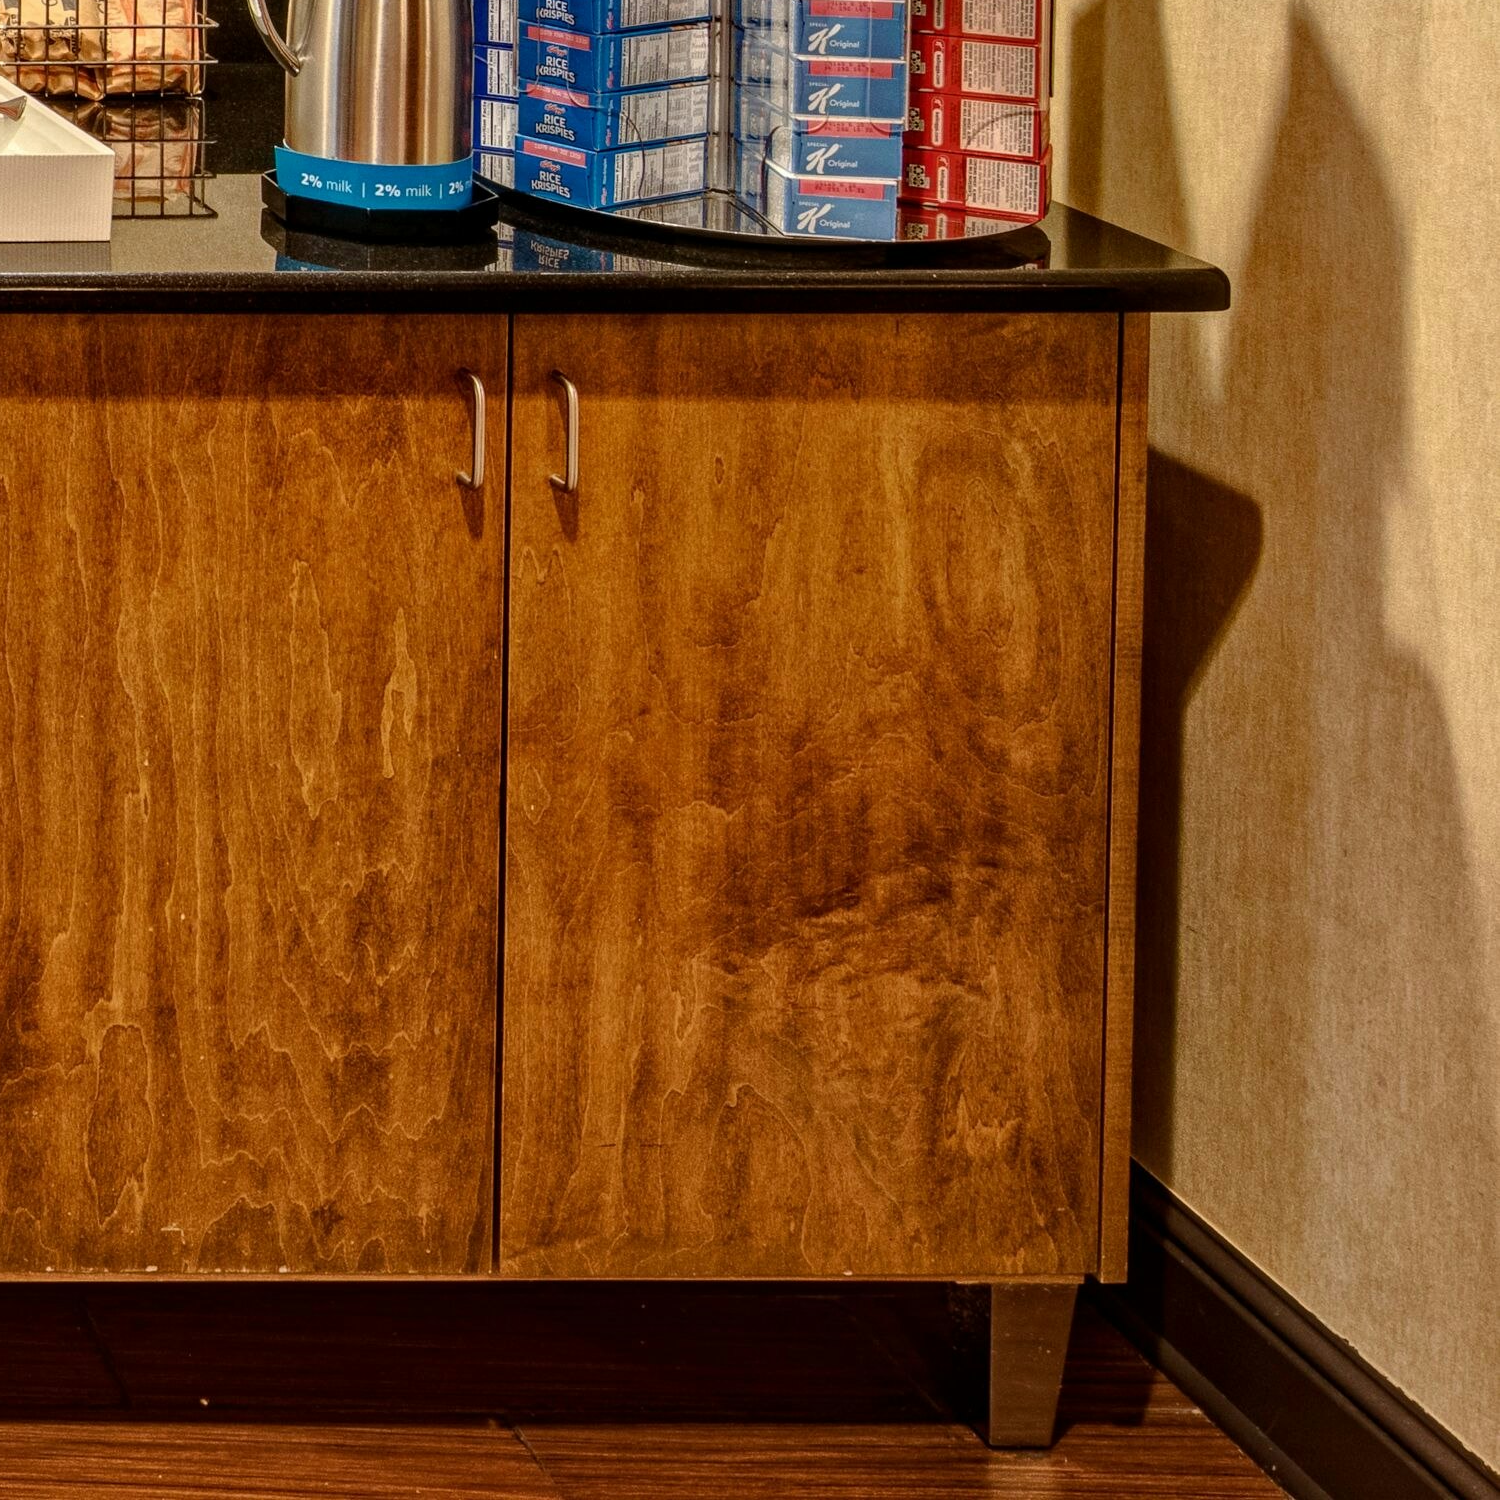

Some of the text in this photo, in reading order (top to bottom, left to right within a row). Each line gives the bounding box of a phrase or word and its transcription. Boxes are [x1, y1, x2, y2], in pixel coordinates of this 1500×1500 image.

[536, 7, 575, 26] KRISPIES
[808, 23, 859, 54] K Original
[545, 56, 569, 70] RICE
[536, 65, 575, 83] KRISPIES
[807, 83, 860, 114] K Original
[544, 114, 566, 128] RICE
[535, 123, 575, 141] KRISPIES
[806, 143, 858, 174] K Original
[301, 173, 352, 193] 2% milk
[539, 171, 562, 185] RICE
[374, 183, 432, 197] 2% milk
[448, 181, 464, 195] 2%
[531, 179, 571, 198] KRISPIES
[797, 203, 850, 234] K Original
